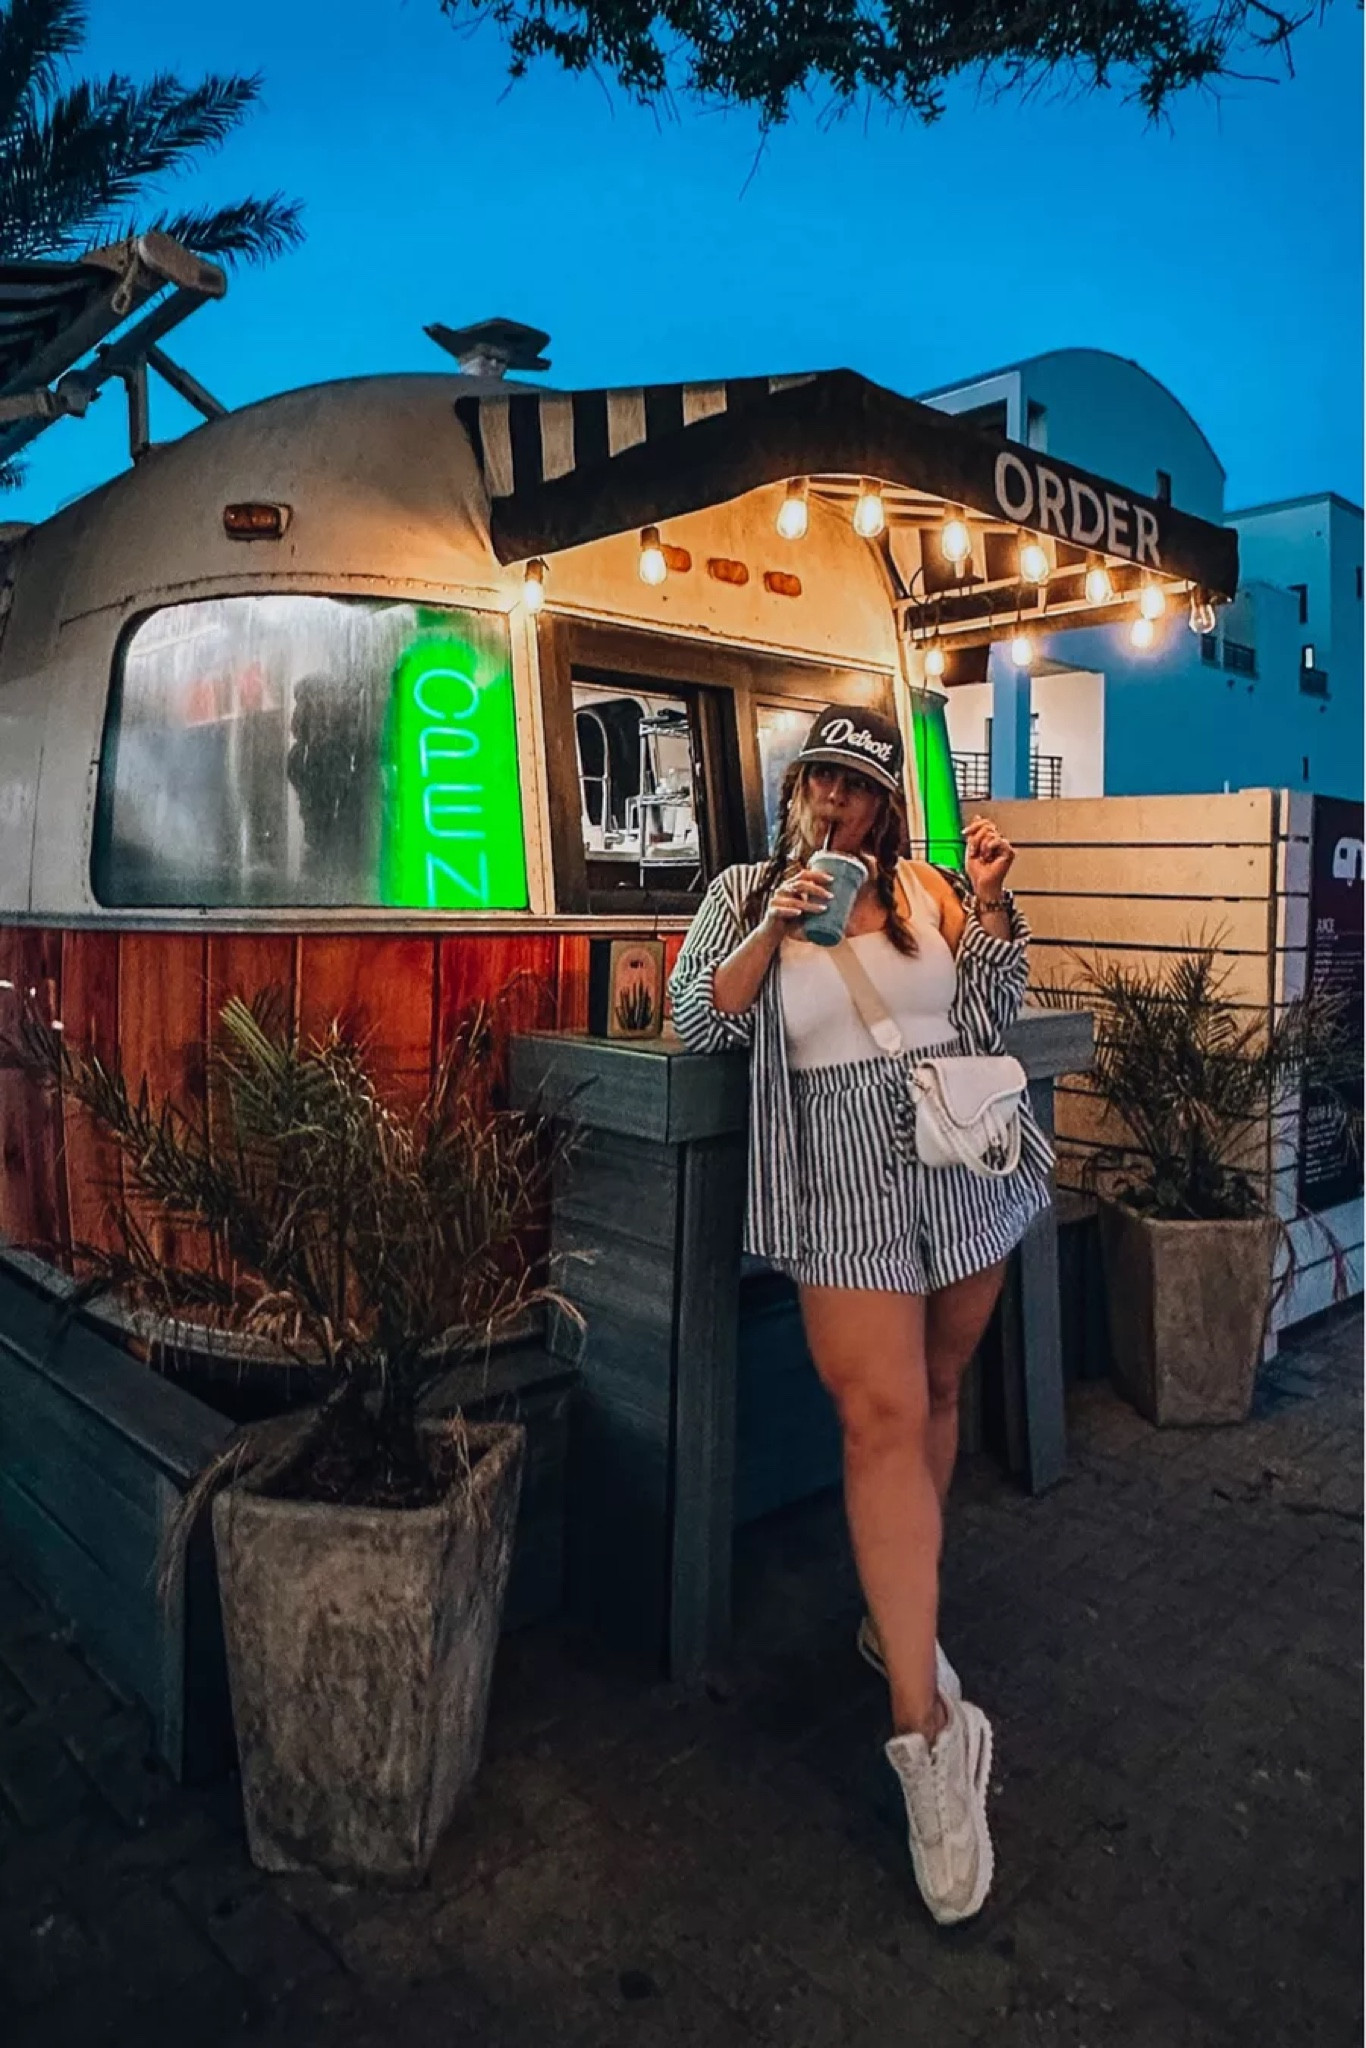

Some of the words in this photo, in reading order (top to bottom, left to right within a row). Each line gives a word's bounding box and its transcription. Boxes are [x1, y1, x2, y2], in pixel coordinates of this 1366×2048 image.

[995, 452, 1161, 567] ORDER
[413, 668, 489, 907] OPEN
[820, 719, 893, 762] Detroit
